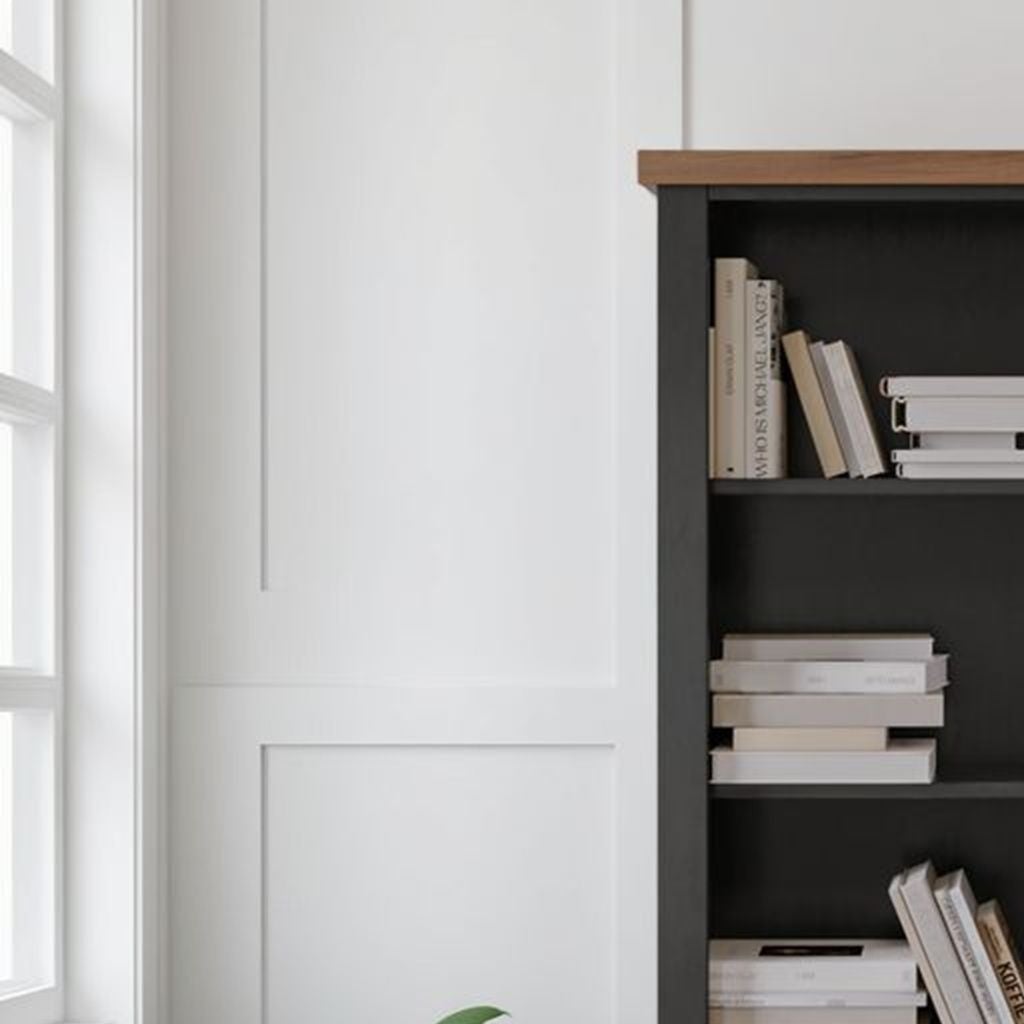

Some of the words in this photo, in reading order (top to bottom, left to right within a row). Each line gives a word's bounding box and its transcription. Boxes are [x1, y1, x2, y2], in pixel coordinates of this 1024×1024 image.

[754, 350, 768, 418] MICHAEL
[754, 418, 768, 433] IS
[754, 436, 768, 478] WHO
